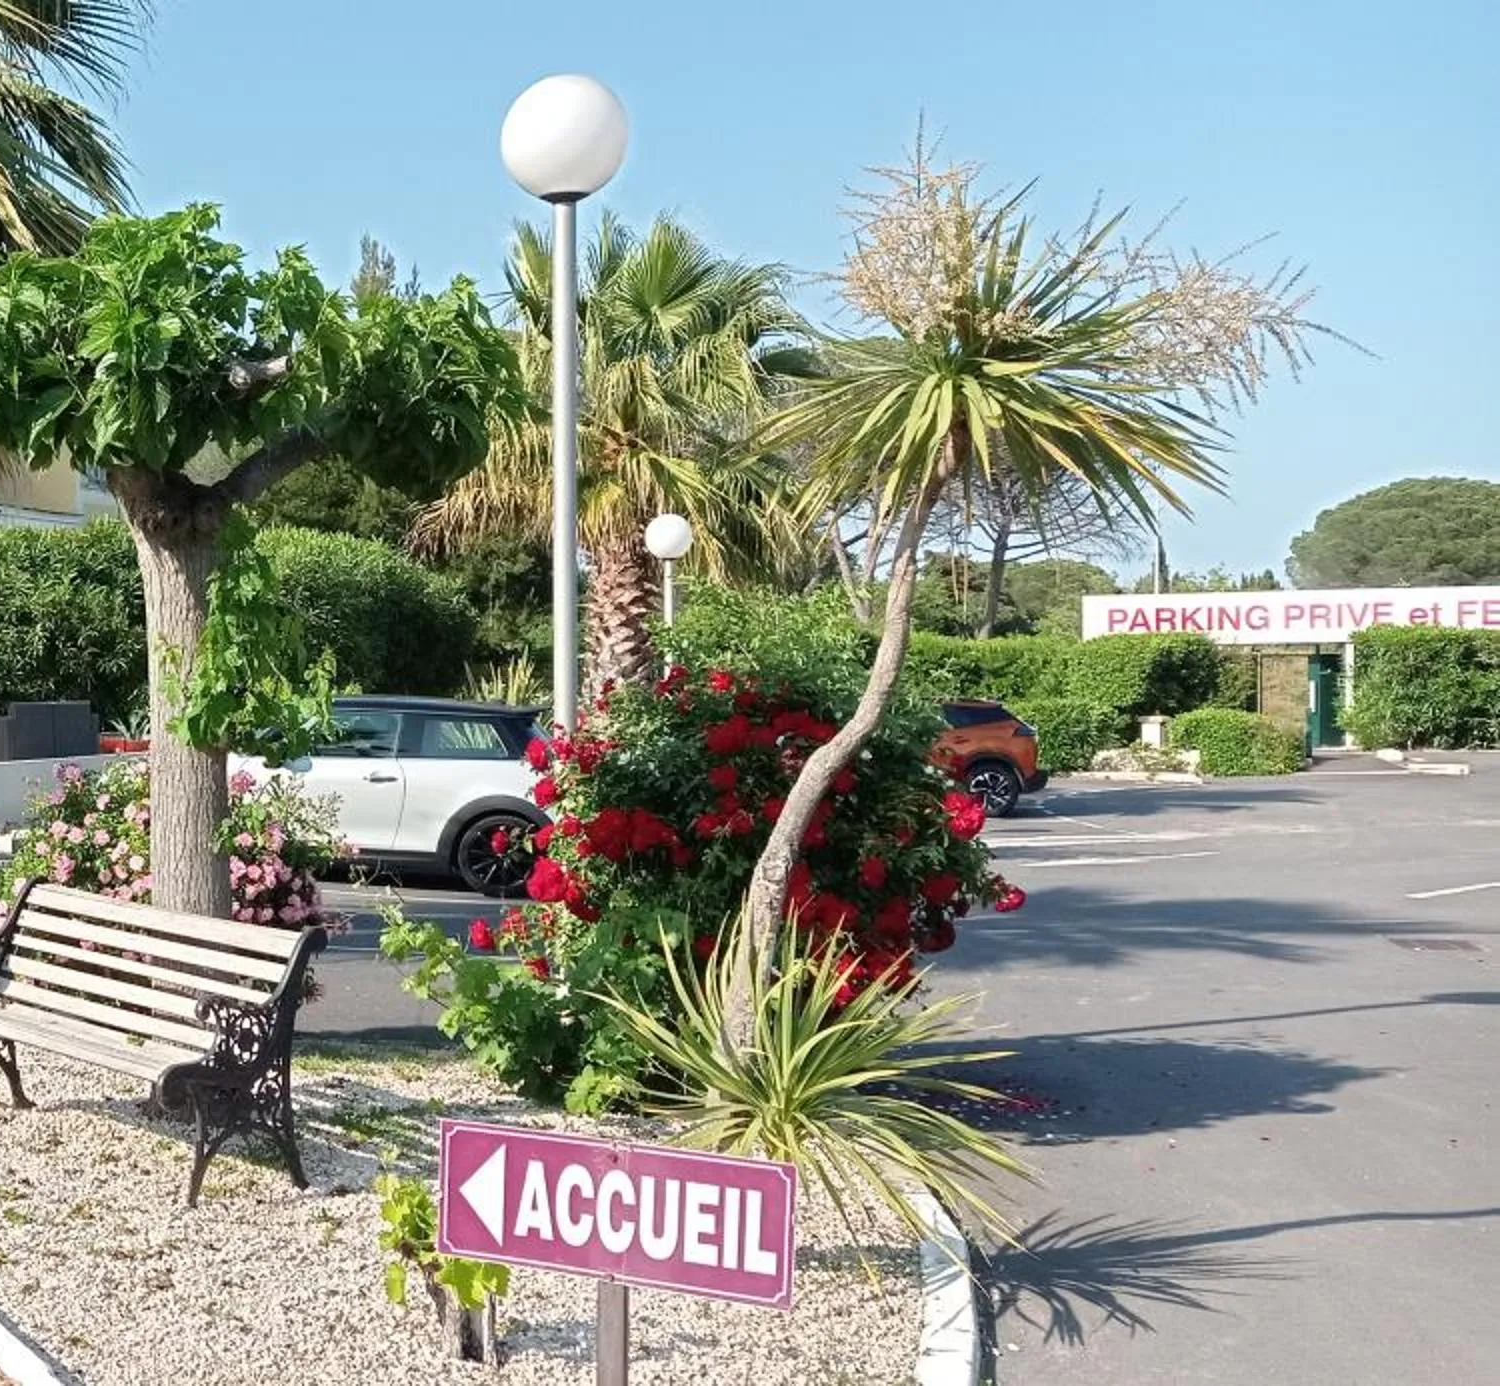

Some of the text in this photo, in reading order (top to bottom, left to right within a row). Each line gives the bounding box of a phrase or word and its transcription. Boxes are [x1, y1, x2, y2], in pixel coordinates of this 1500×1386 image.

[1107, 599, 1500, 633] PARKING PRIVE et FE
[513, 1159, 778, 1276] ACCUEIL
